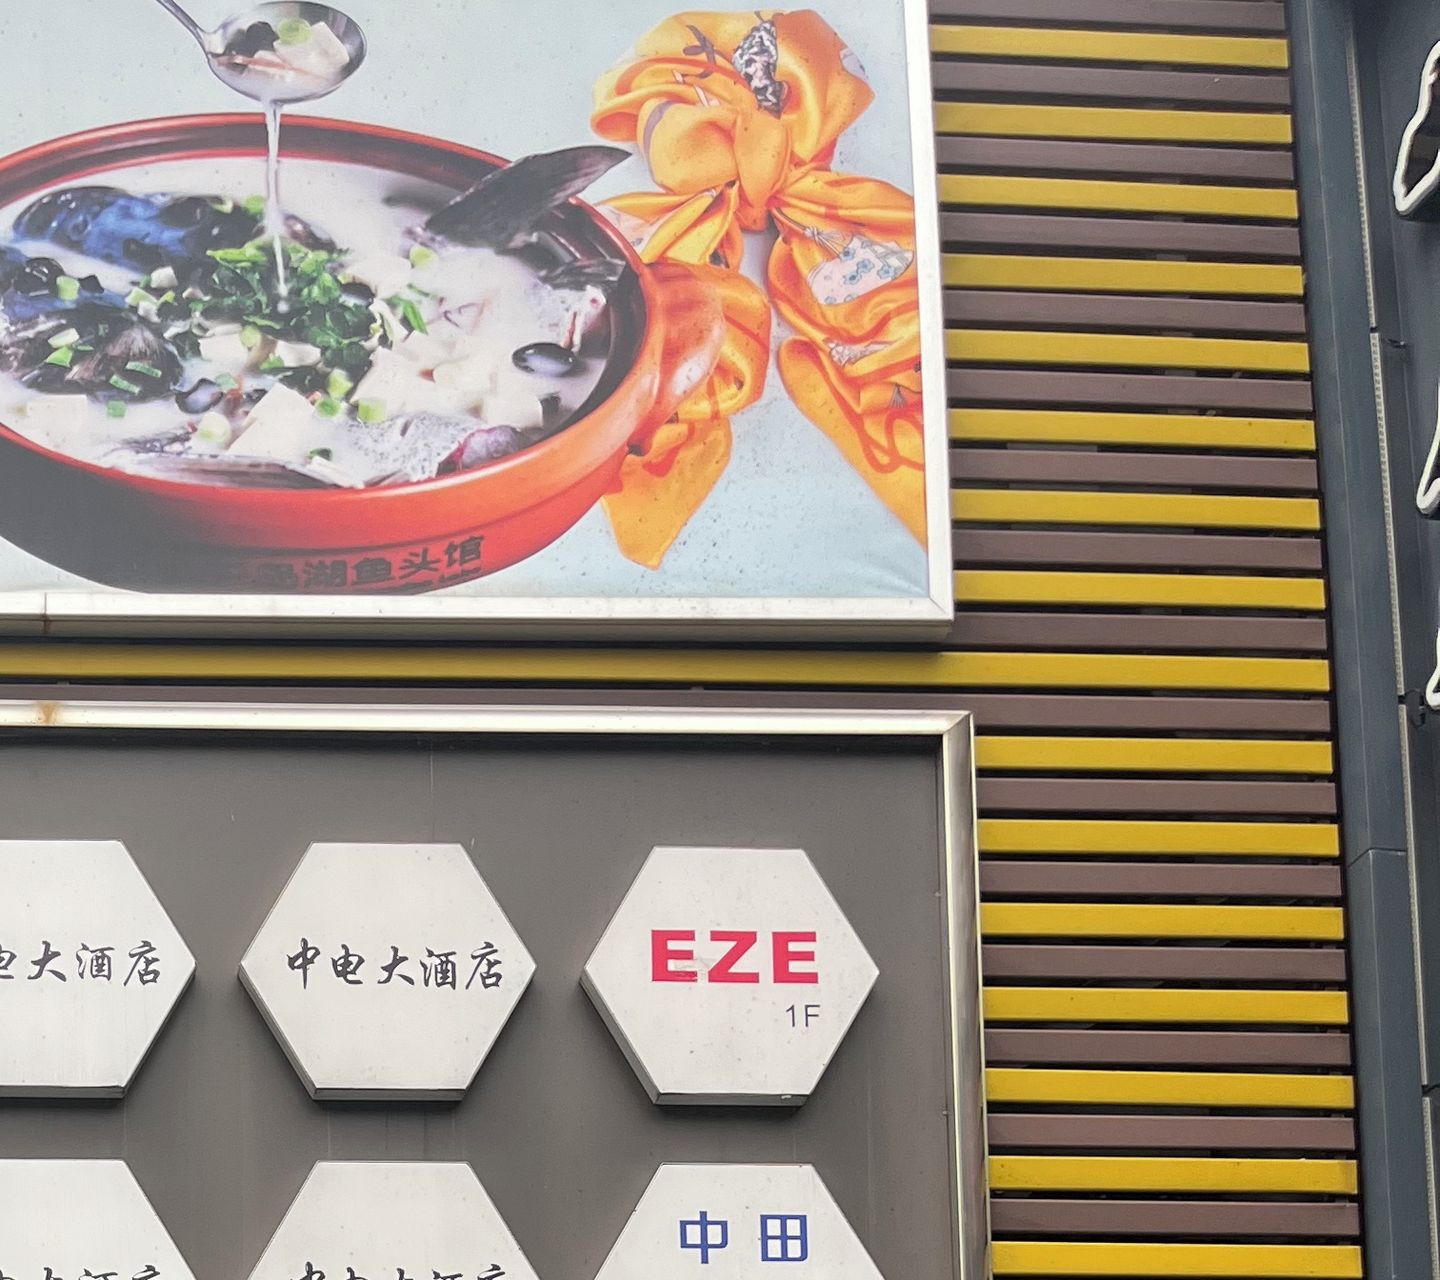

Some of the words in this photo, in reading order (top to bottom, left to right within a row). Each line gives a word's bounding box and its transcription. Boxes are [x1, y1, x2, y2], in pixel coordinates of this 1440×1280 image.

[285, 937, 504, 990] 中电大酒店
[650, 929, 819, 985] EZE
[785, 1004, 821, 1028] 1F
[679, 1210, 809, 1265] 中田
